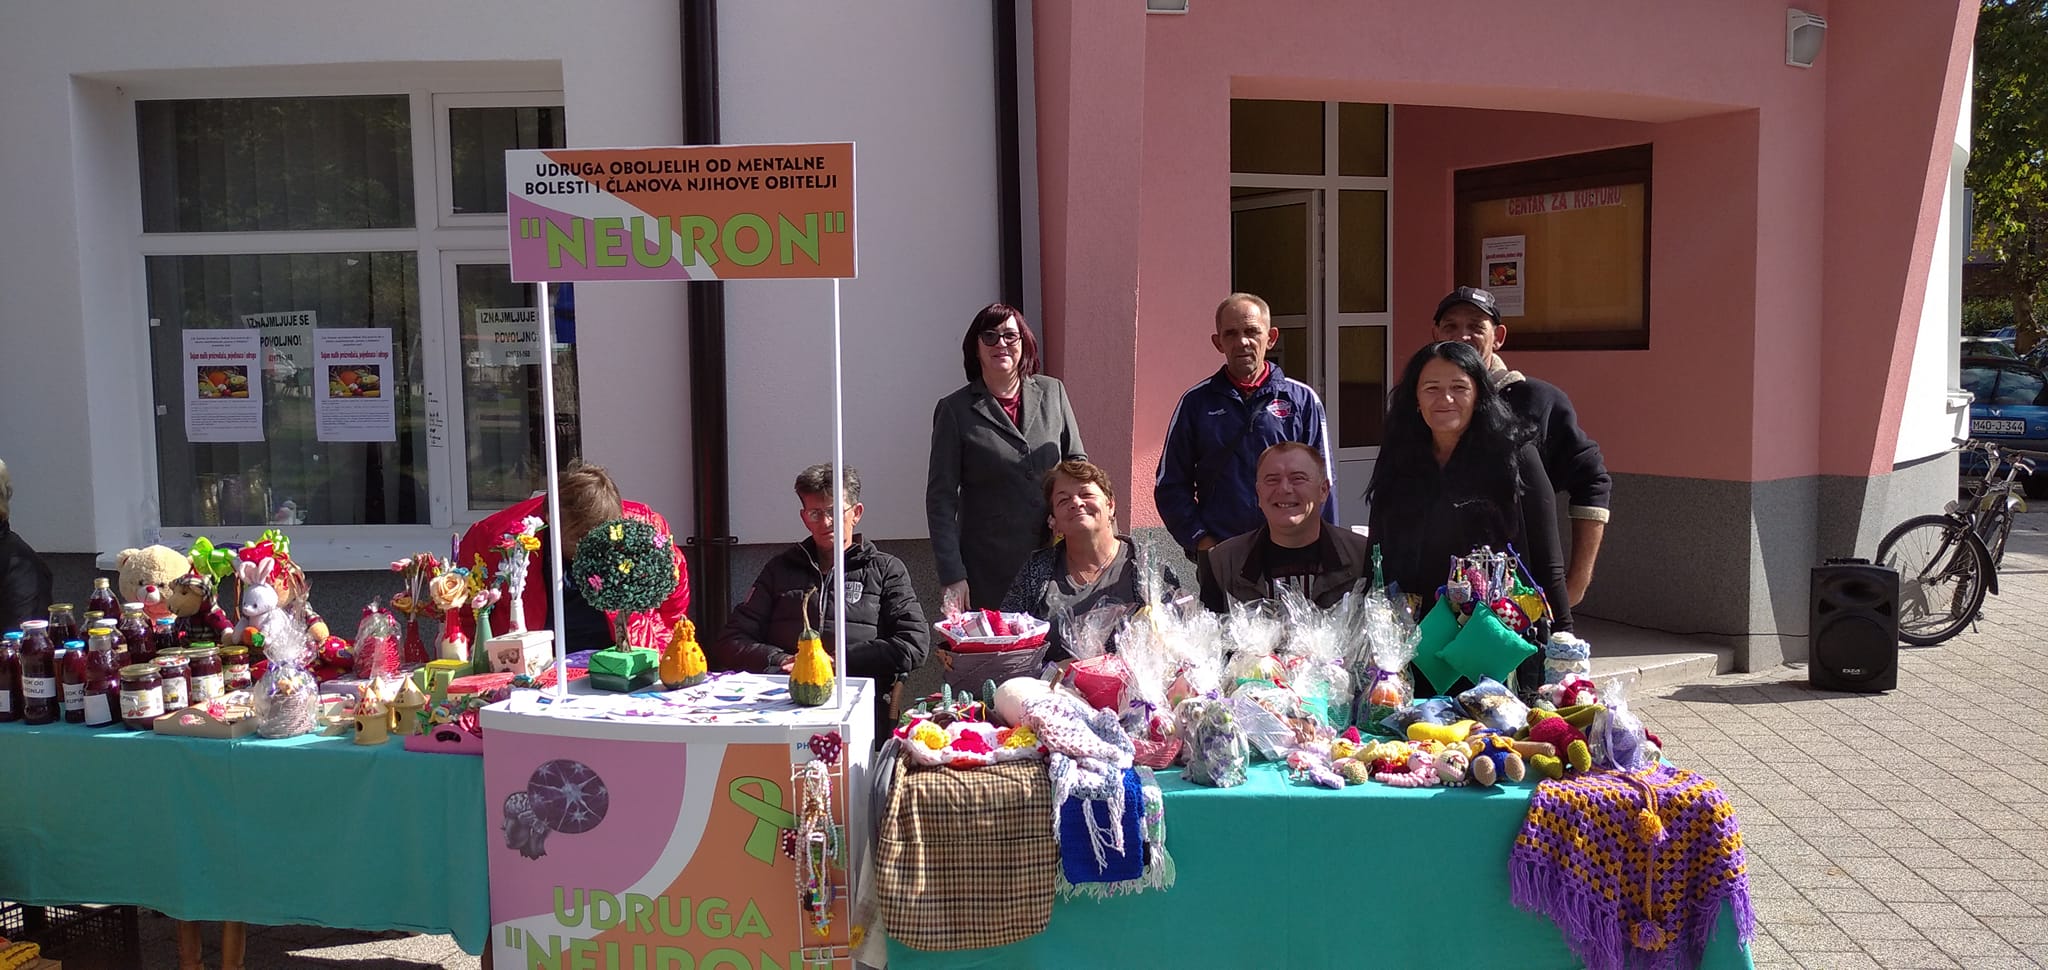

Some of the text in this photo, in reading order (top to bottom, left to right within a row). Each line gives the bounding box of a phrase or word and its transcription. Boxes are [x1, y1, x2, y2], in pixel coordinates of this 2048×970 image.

[536, 156, 825, 176] UDRUGA OBOLJELIH OD MENTALNE
[525, 174, 837, 195] BOLESTI I ČLANOVA NJIHOVE OBITELJI
[1508, 195, 1546, 216] CENTAR
[1551, 191, 1568, 211] ZA
[519, 211, 846, 269] "NEURON"
[299, 314, 310, 326] SE
[480, 311, 536, 324] IZNAJMLJUJE
[553, 885, 772, 939] UDRUGA
